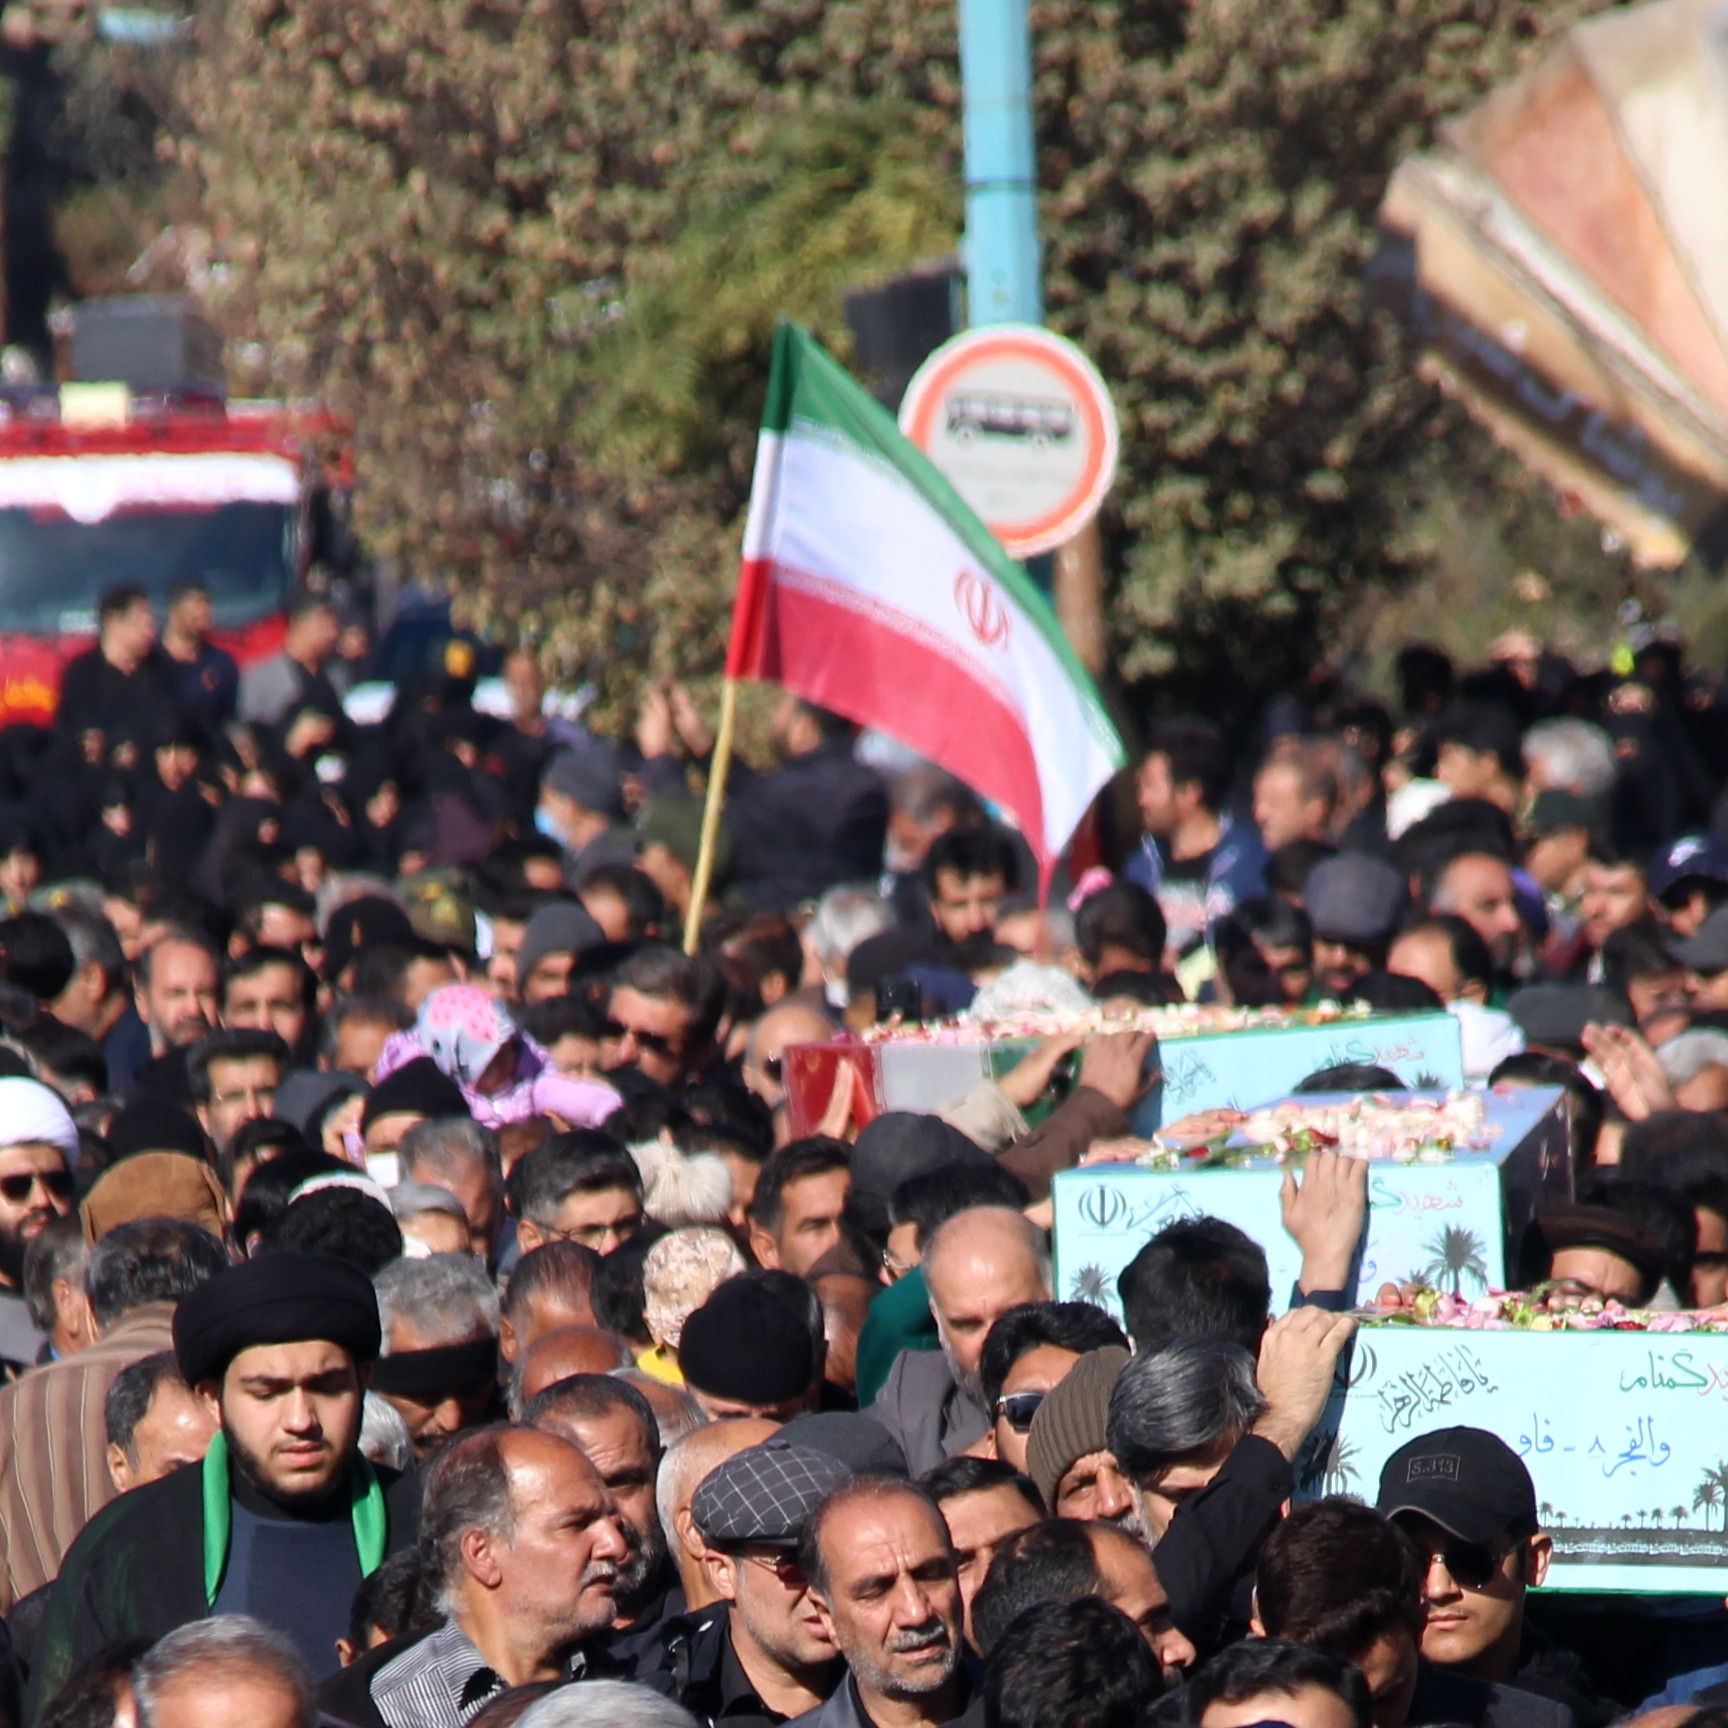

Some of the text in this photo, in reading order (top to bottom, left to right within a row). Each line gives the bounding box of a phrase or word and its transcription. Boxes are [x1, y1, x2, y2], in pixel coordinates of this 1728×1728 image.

[1392, 1180, 1463, 1221] شهید
[1619, 1349, 1709, 1393] گمنام
[1519, 1411, 1555, 1457] فاو
[1602, 1414, 1671, 1478] والفجر
